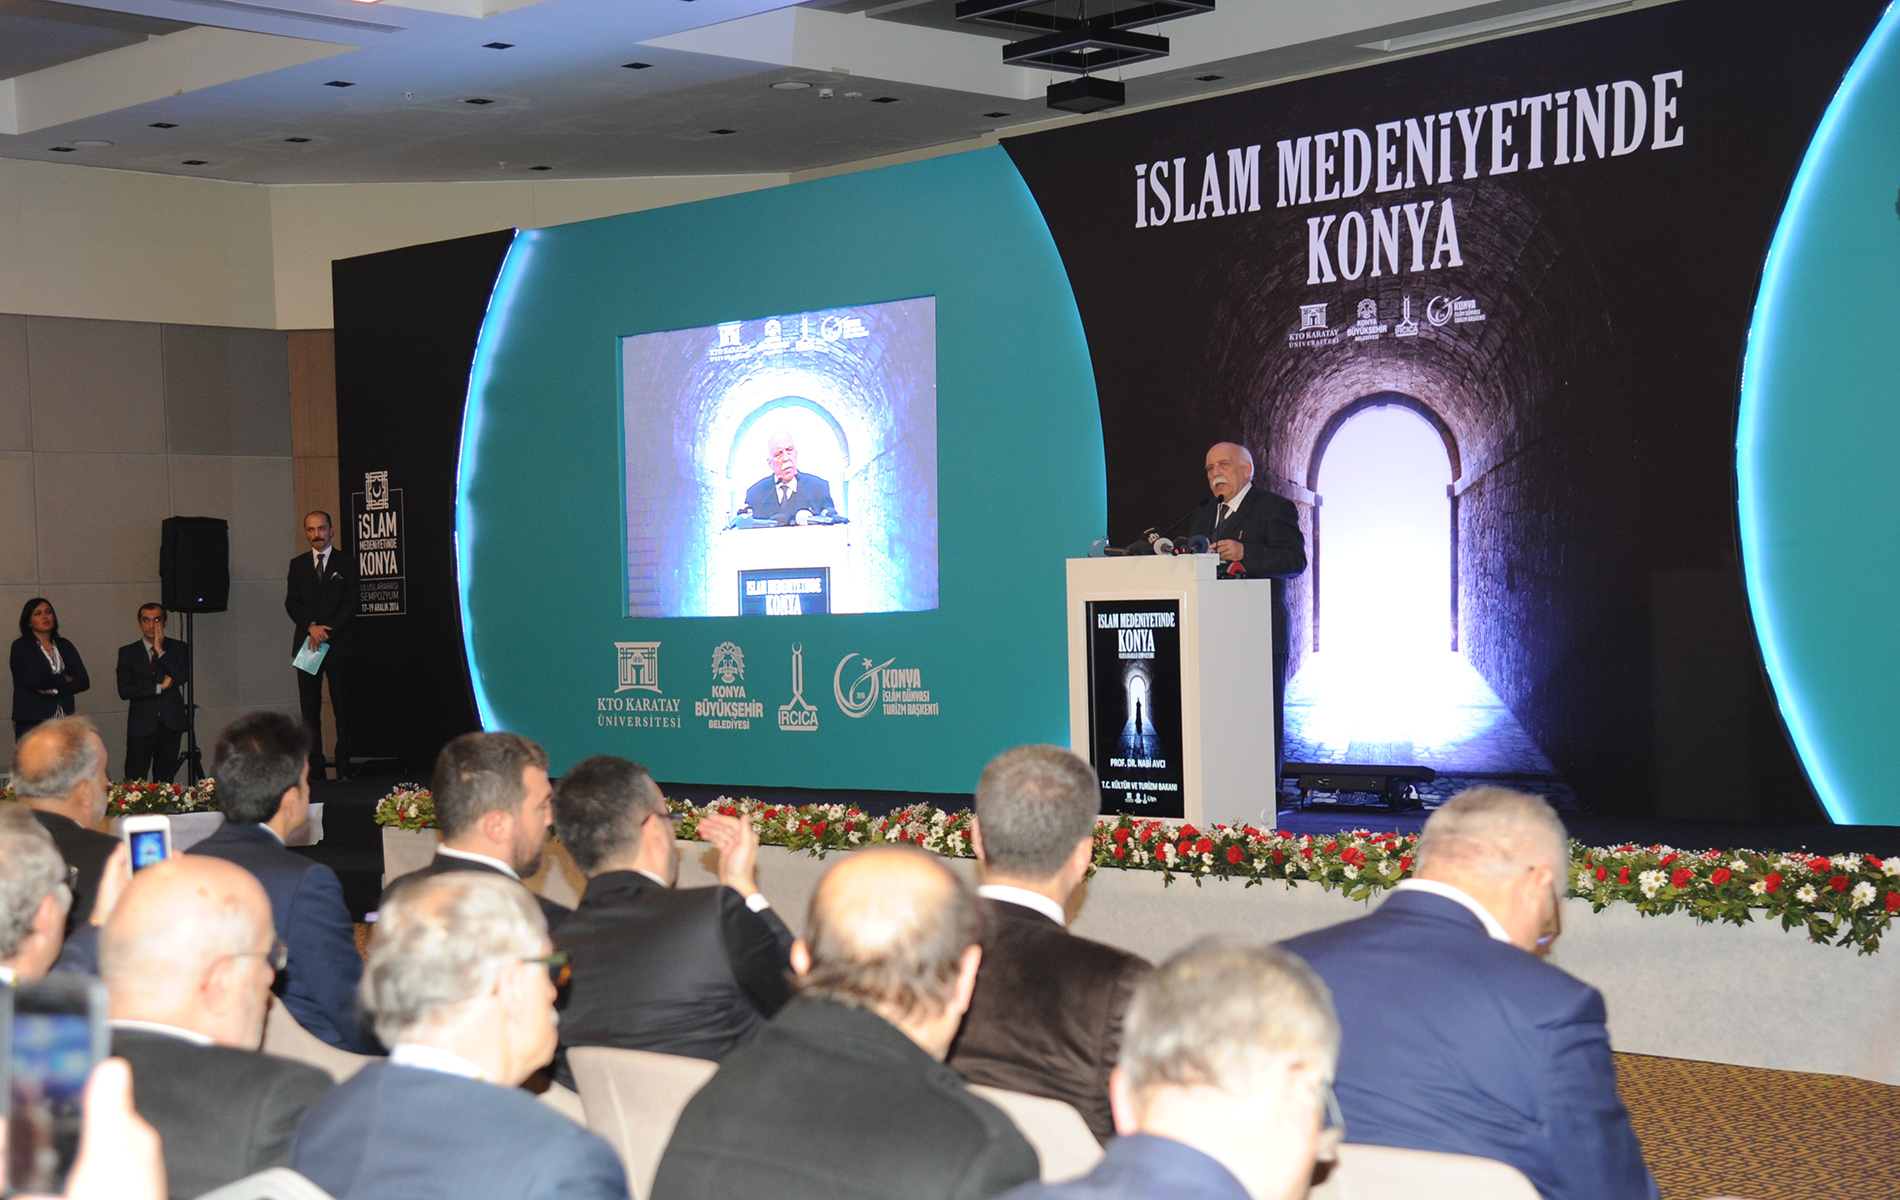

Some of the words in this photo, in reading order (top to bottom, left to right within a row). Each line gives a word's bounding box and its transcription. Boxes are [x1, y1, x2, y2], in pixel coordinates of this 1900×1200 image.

[1135, 144, 1262, 228] İSLAM
[1276, 70, 1684, 208] MEDENİYETİNDE
[1306, 197, 1464, 285] KONYA
[1454, 300, 1476, 311] KONYA
[1289, 333, 1305, 341] KTO
[1306, 329, 1339, 339] KARATAY
[360, 550, 398, 576] KONYA
[360, 591, 399, 601] SEMPOZYUM
[389, 602, 399, 611] 2016
[1118, 629, 1155, 652] KONYA
[882, 668, 921, 688] KONYA
[711, 685, 746, 698] KONYA
[902, 688, 930, 702] DÜNYASI
[597, 698, 623, 711] KTO
[626, 699, 680, 712] KARATAY
[695, 699, 764, 719] BÜYÜKŞEHİR
[883, 703, 906, 715] TURİZM
[907, 702, 939, 717] BAŞKENTİ
[598, 713, 681, 728] ÜNİVERSİTESİ
[708, 718, 750, 730] BELEDİYESİ
[778, 710, 819, 725] IRCICA
[1110, 758, 1127, 767] PROF.
[1127, 758, 1137, 767] DR.
[1137, 758, 1152, 768] NABİ
[1152, 760, 1166, 768] AVCI
[1101, 781, 1111, 789] T.C.
[1111, 780, 1130, 790] KÜLTÜR
[1131, 782, 1138, 790] VE
[1138, 781, 1158, 790] TURİZM
[1158, 783, 1178, 791] BAKANI
